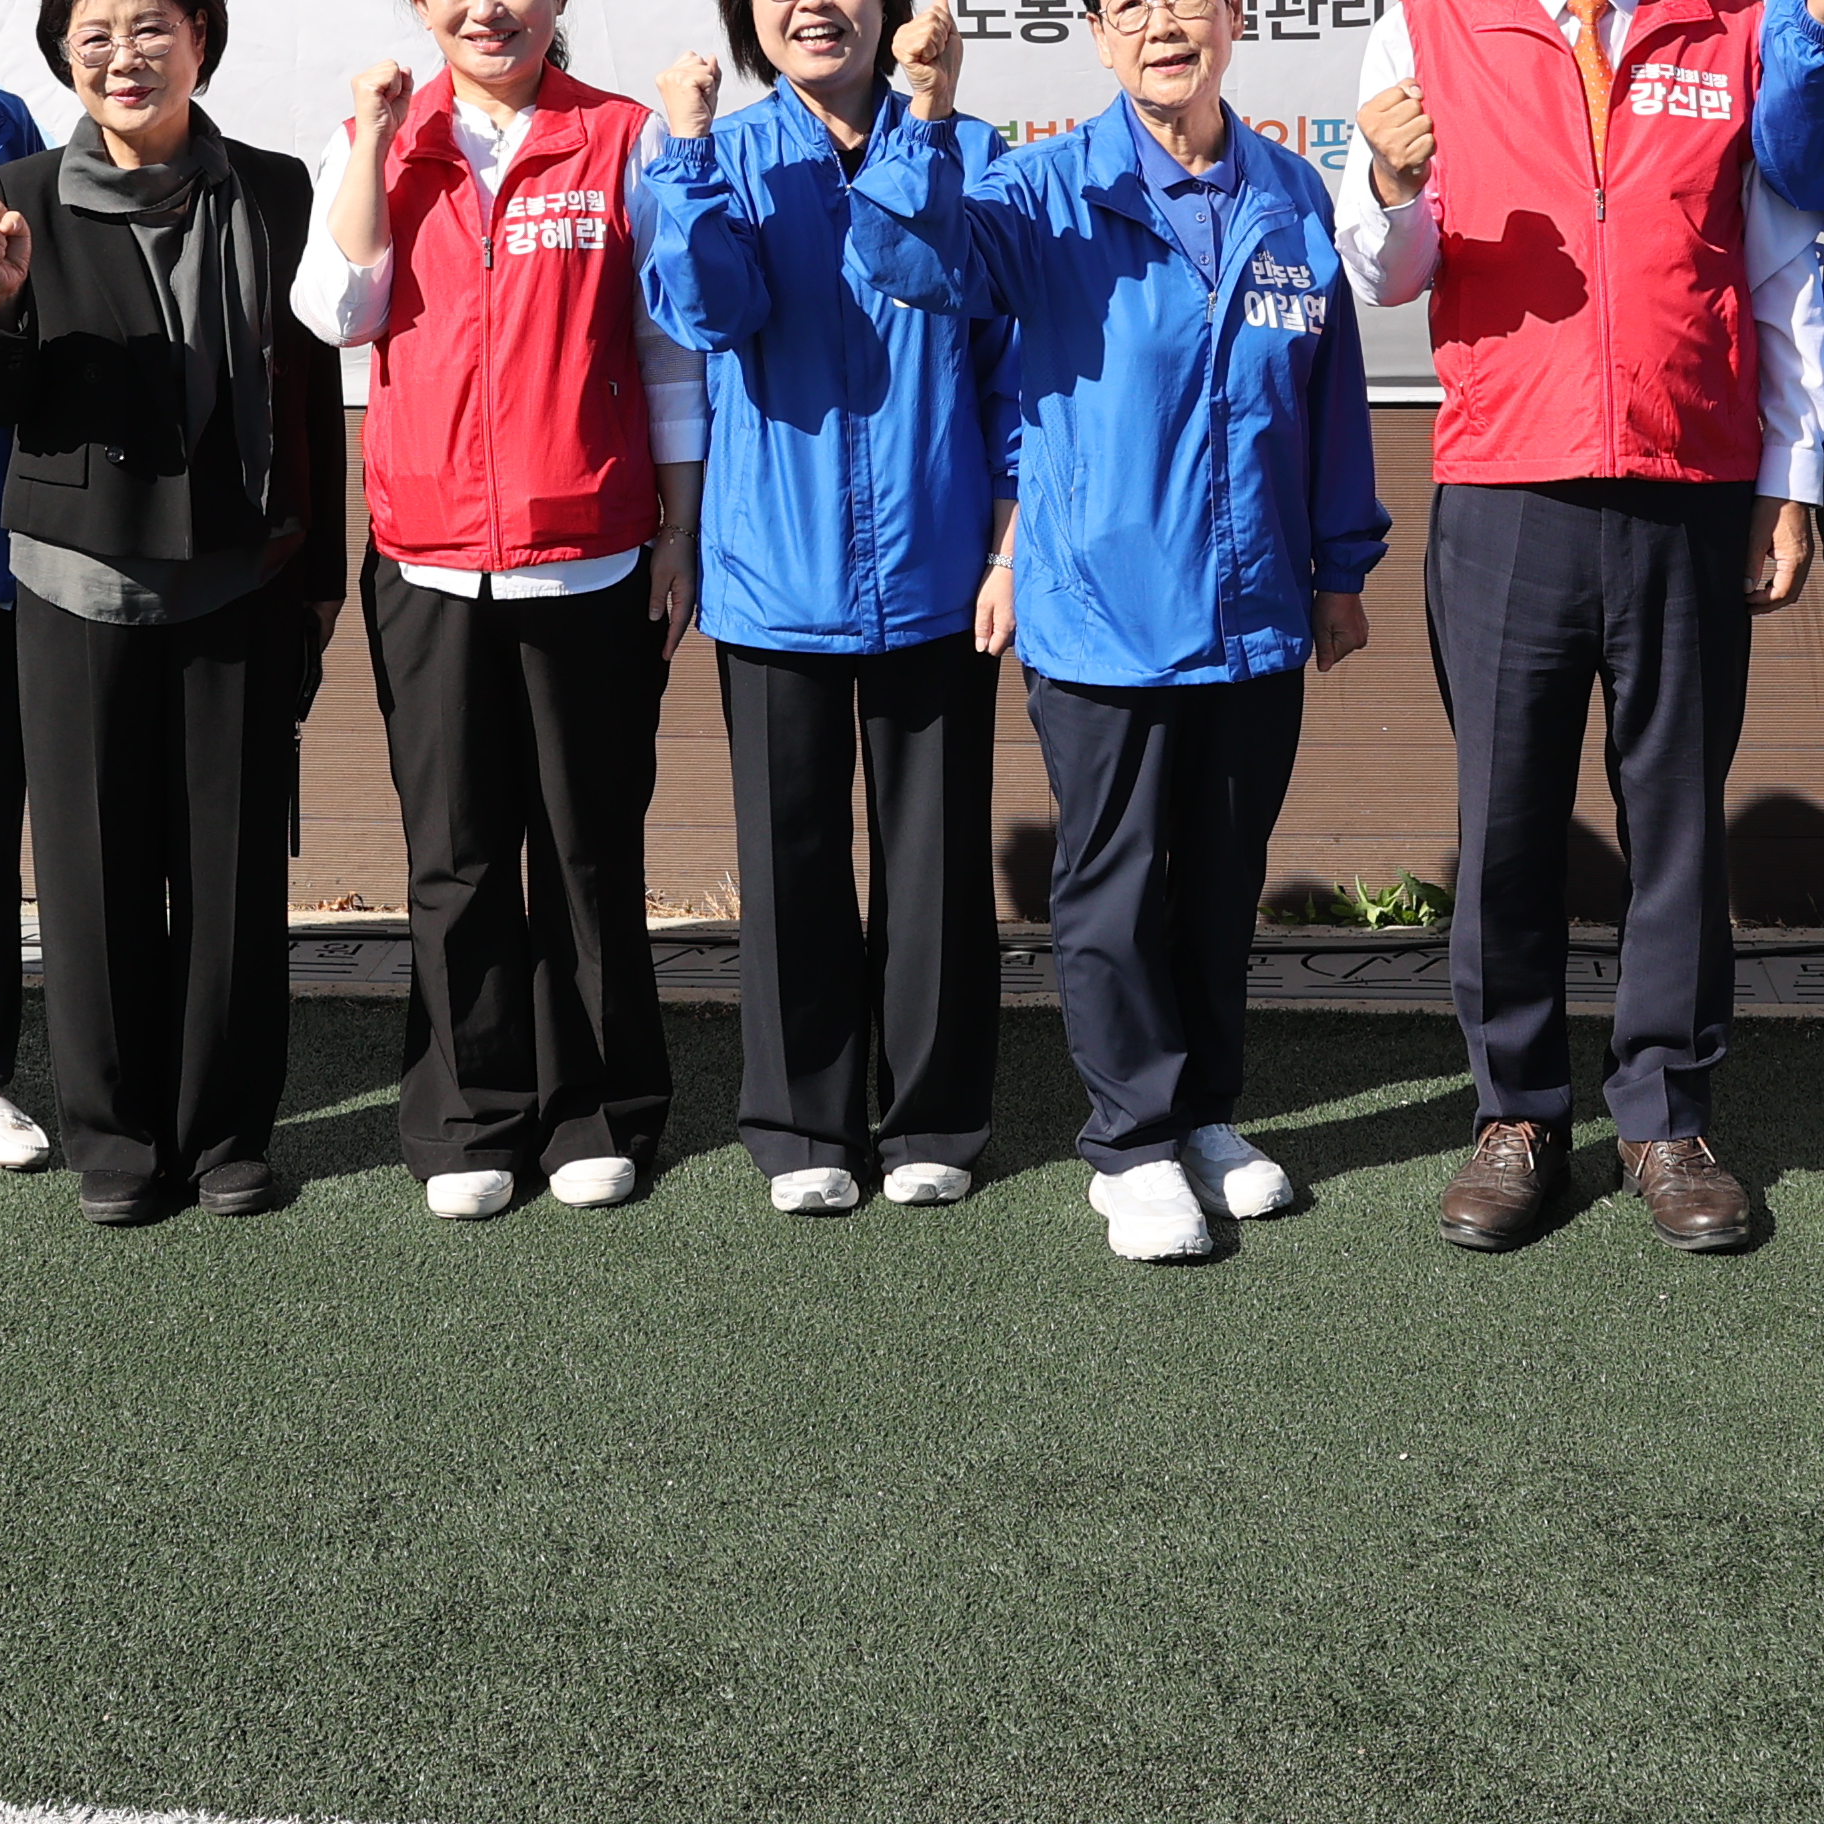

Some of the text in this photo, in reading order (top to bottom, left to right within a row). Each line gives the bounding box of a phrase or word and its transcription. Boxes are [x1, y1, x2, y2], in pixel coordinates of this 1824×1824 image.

[1631, 64, 1728, 88] 도봉구의회 의장
[1630, 81, 1732, 120] 강신만
[505, 190, 607, 219] 도봉구의원
[1251, 260, 1312, 289] 민주당
